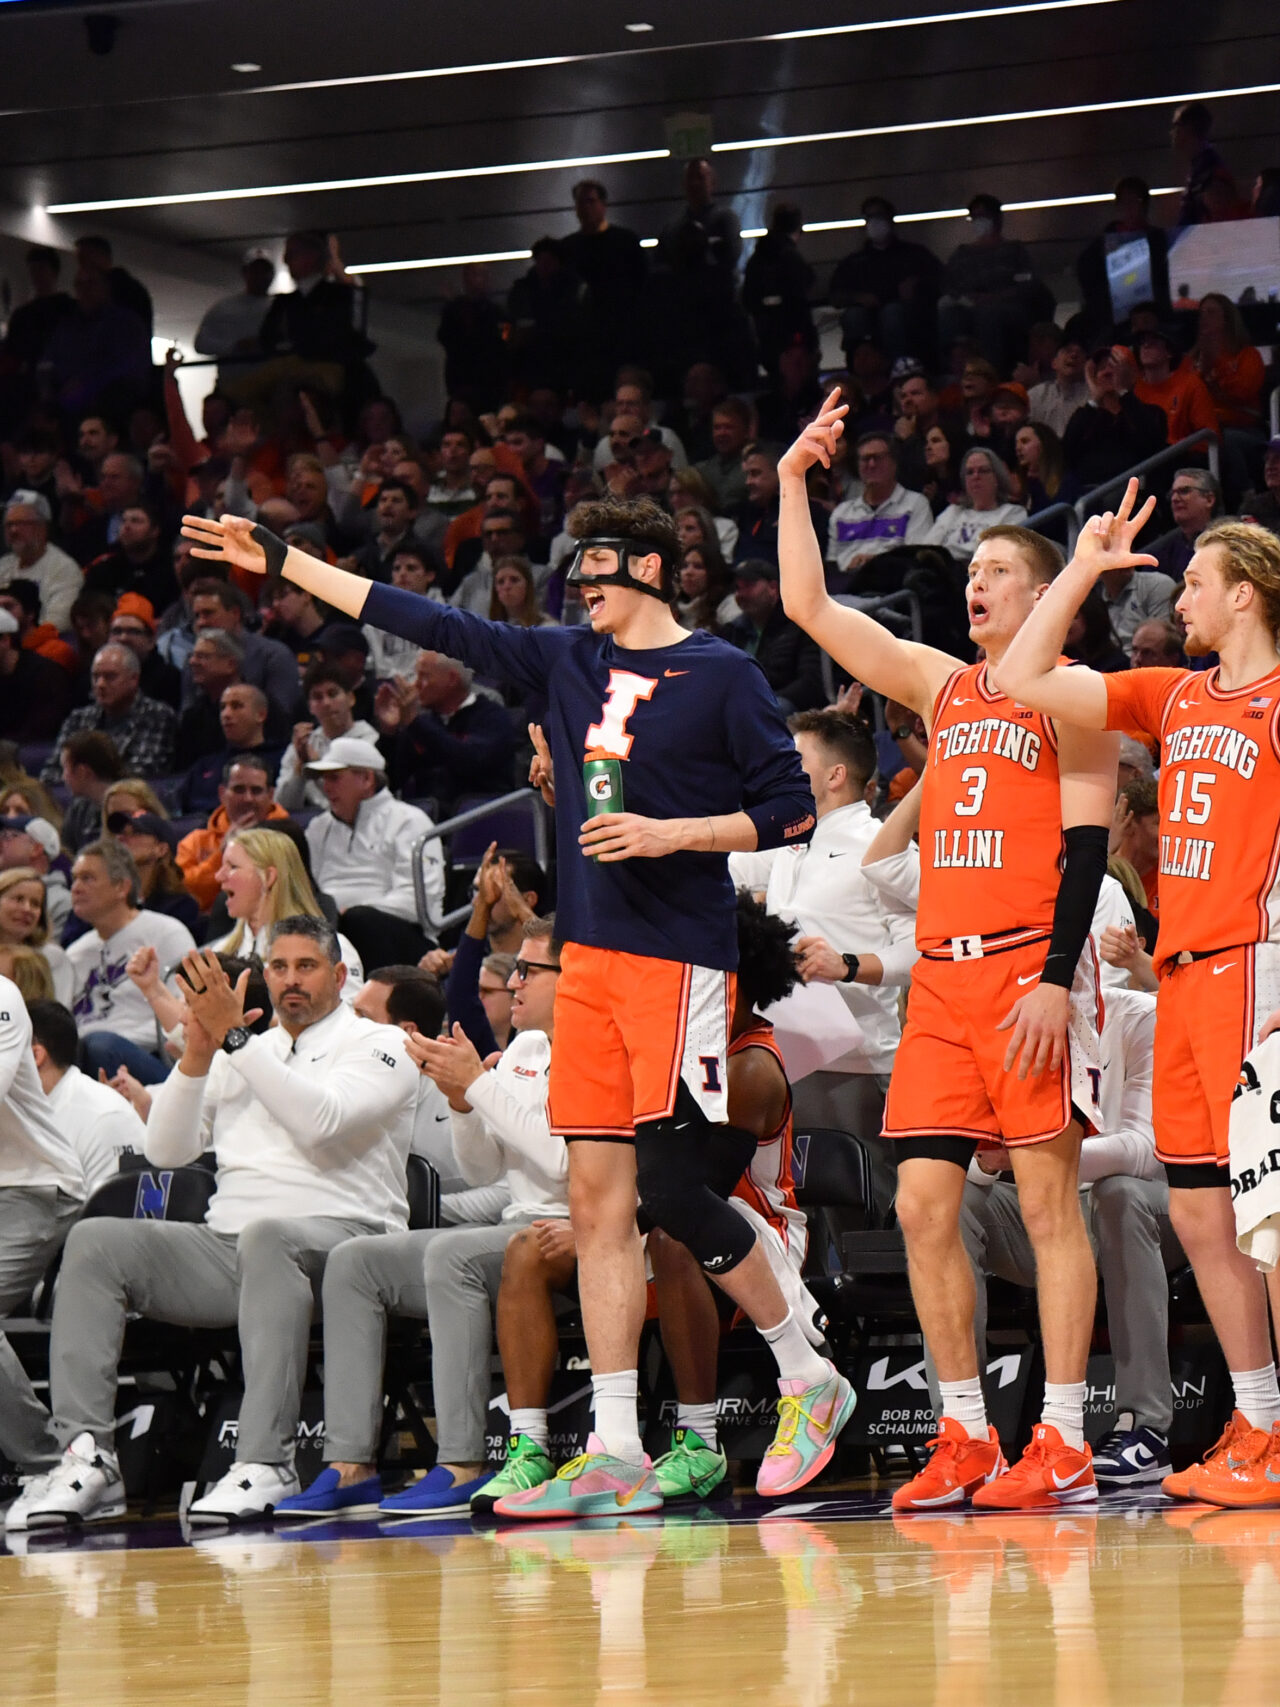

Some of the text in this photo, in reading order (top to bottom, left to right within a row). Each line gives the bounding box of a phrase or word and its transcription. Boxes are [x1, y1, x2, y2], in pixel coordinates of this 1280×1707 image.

[584, 669, 659, 760] I
[935, 718, 1041, 771] FIGHTING
[589, 774, 612, 800] G
[954, 766, 988, 816] 3
[1168, 770, 1217, 825] 15
[933, 829, 1004, 868] ILLINI
[1160, 834, 1216, 880] ILLINI
[960, 939, 972, 957] I
[699, 1056, 722, 1093] I
[881, 1409, 911, 1421] BOB
[1173, 1399, 1204, 1410] OUP
[867, 1423, 938, 1435] SCHAUMB
